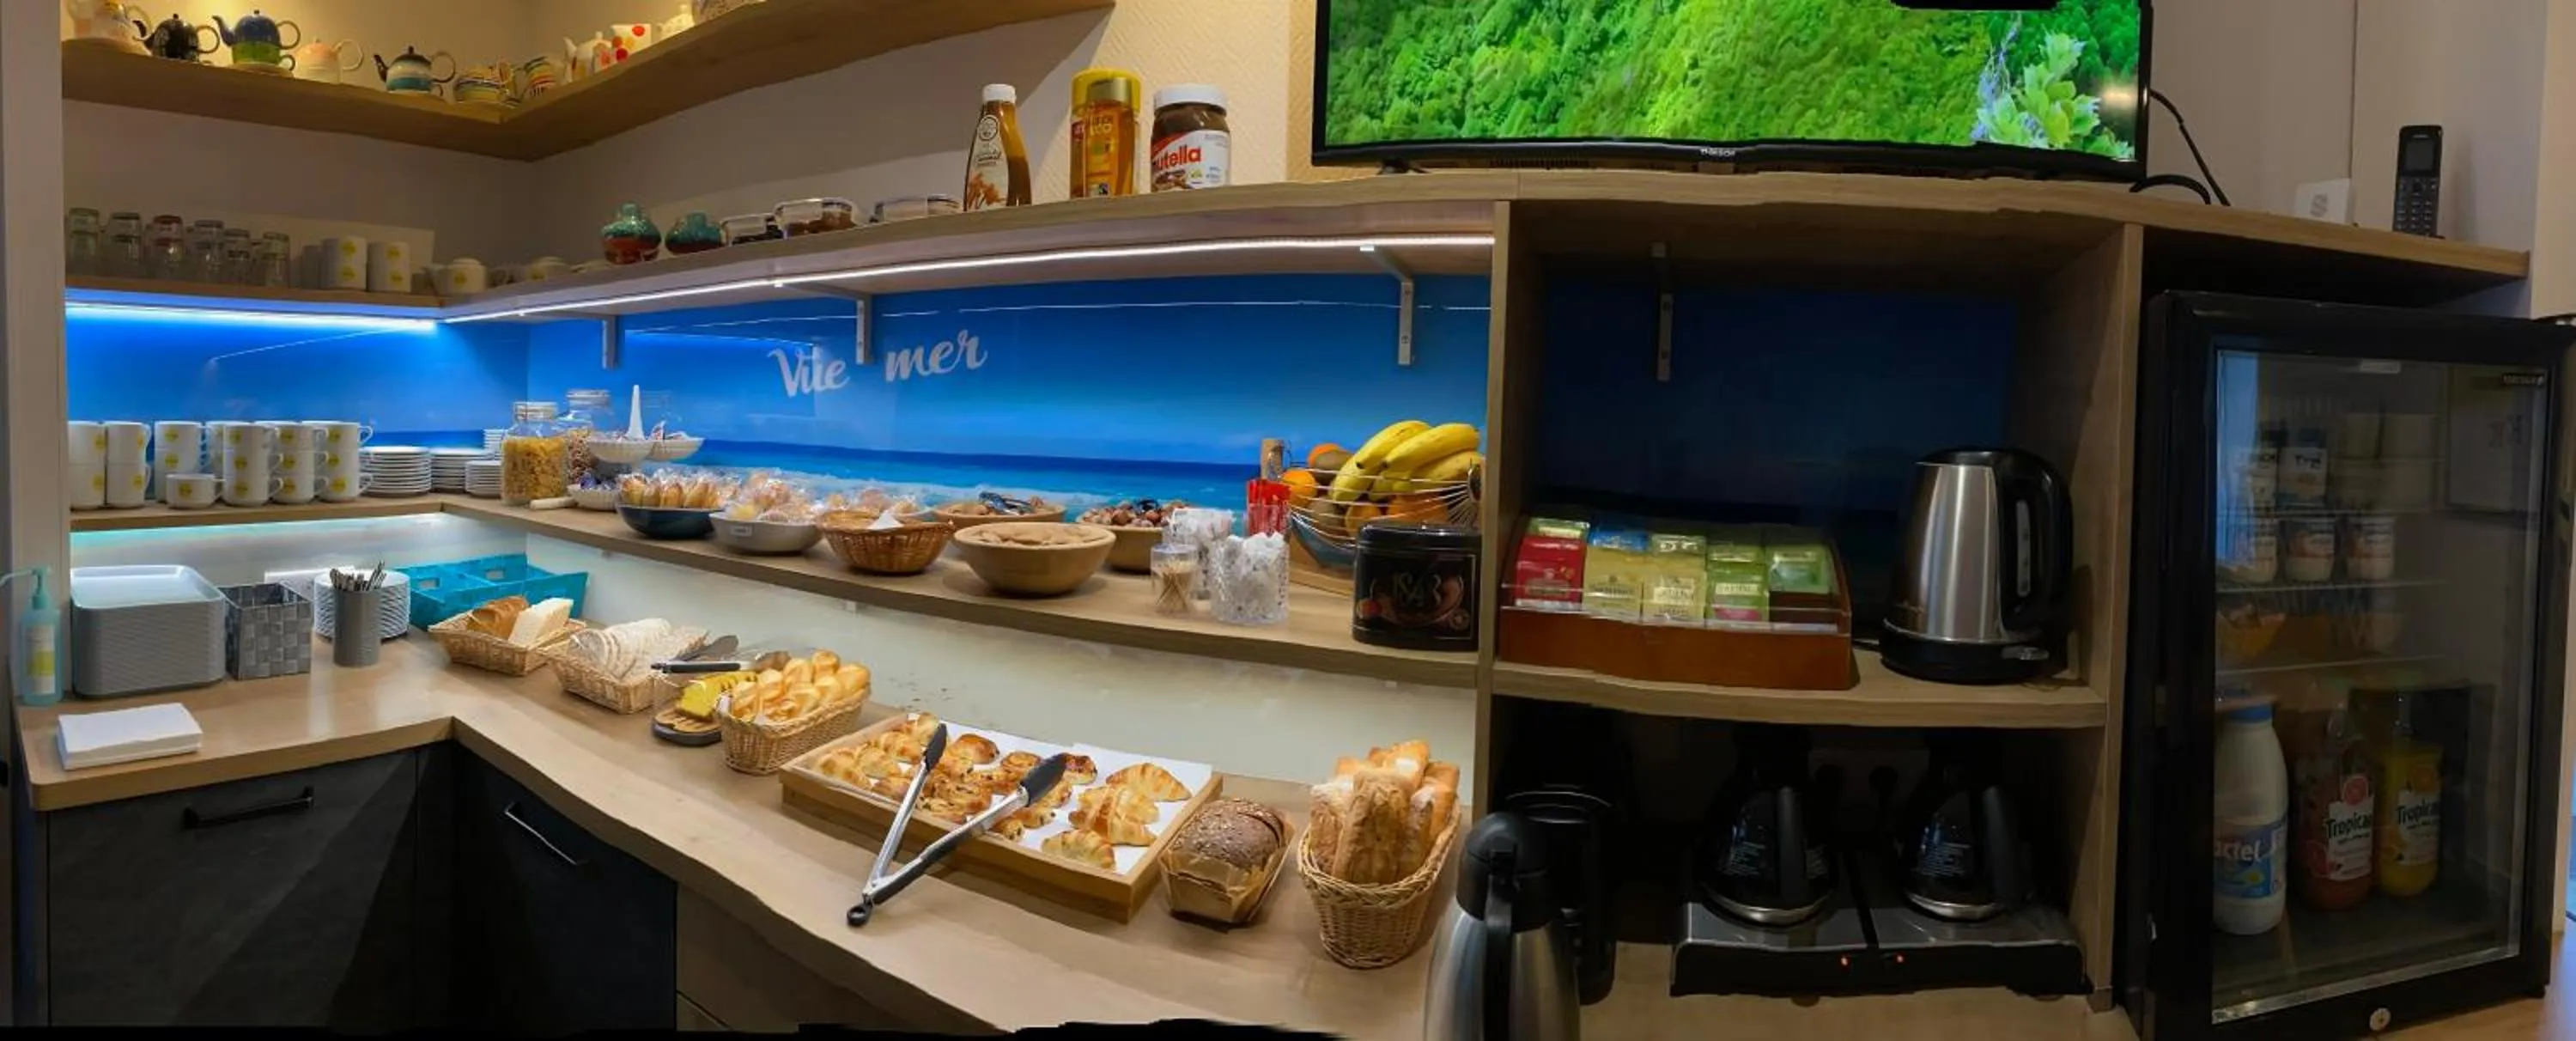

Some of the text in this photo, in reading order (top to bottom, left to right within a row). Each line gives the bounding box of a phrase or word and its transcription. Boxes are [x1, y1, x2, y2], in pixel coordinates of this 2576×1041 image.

[885, 329, 988, 382] mer
[2397, 799, 2440, 825] Tropica
[2214, 838, 2263, 862] actel
